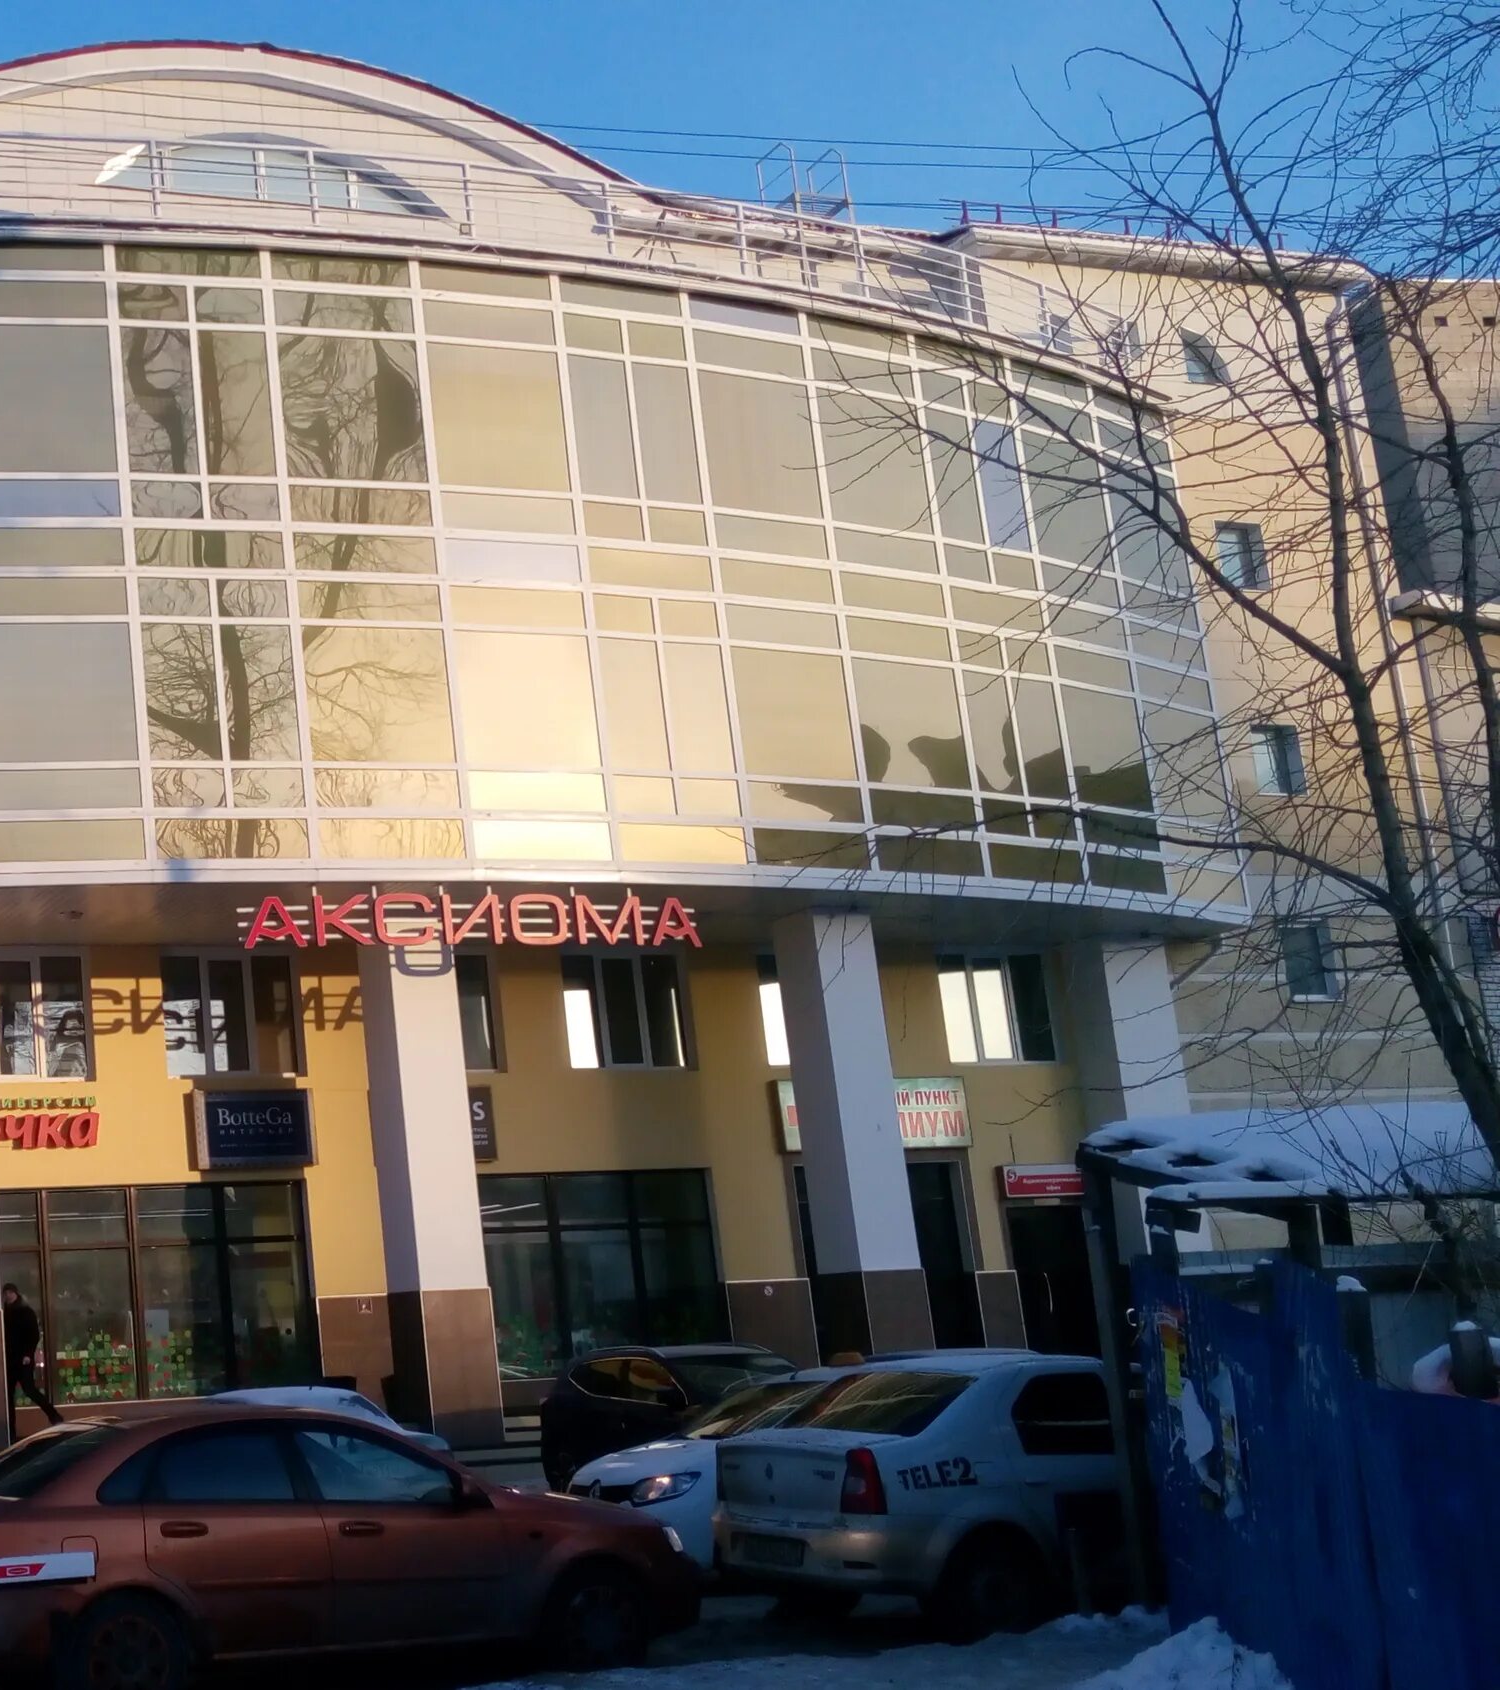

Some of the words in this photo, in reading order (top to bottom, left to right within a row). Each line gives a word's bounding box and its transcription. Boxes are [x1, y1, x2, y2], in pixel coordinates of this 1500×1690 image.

[244, 893, 702, 950] АКСИОМА
[914, 1089, 959, 1106] ПУНКТ
[217, 1107, 292, 1126] BotteGa
[896, 1456, 979, 1491] TELE2
